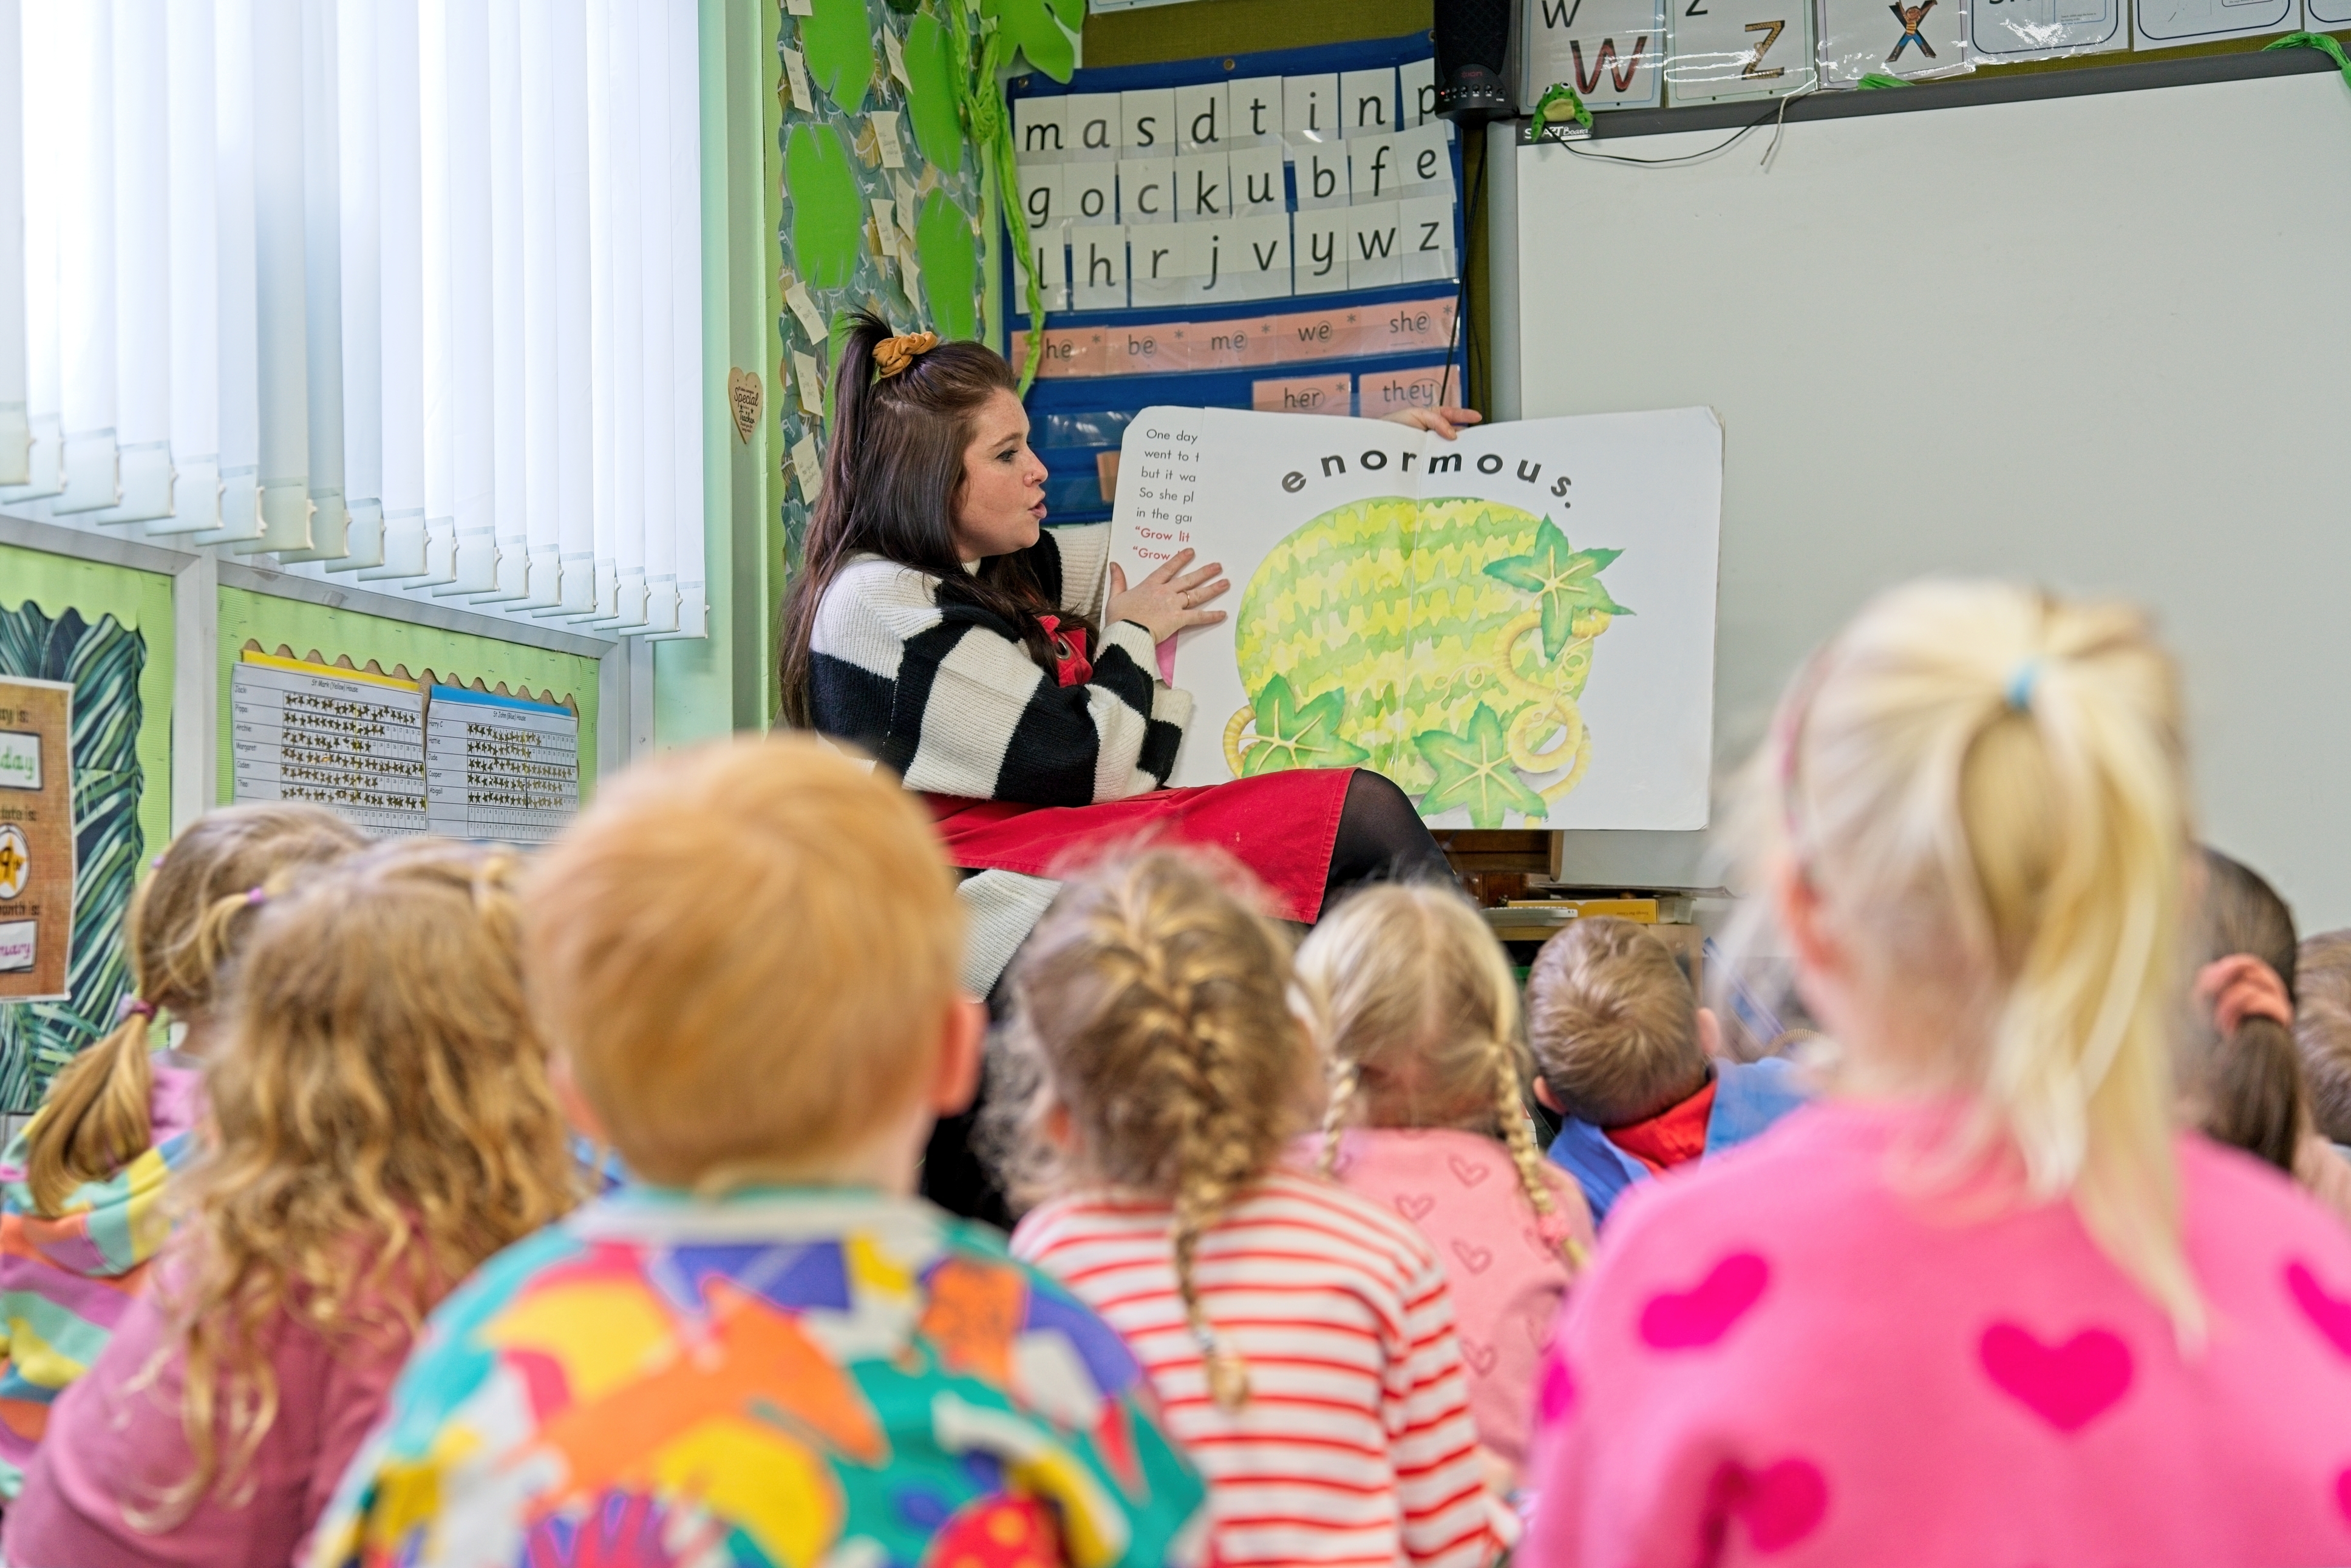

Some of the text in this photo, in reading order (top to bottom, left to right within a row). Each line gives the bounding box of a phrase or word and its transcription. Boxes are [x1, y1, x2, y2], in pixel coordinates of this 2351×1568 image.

[1026, 84, 1435, 151] m a s d t i n p
[1525, 126, 1563, 139] SART
[1029, 146, 1436, 228] g o c k u b f e
[1038, 222, 1438, 290] l h r j v y w z
[1046, 311, 1427, 358] he be me we she
[734, 387, 758, 407] Special
[1284, 380, 1434, 408] her they
[739, 410, 755, 424] Teacher
[1147, 429, 1197, 444] One day
[1145, 450, 1171, 459] went
[1179, 451, 1188, 461] to
[1141, 466, 1159, 478] but
[1166, 470, 1172, 479] it
[1282, 450, 1571, 509] enormous.
[1140, 487, 1193, 504] So she pl
[1137, 507, 1145, 517] in
[1152, 508, 1169, 520] the
[1179, 531, 1190, 543] lit
[330, 681, 345, 692] (Yellow)
[235, 704, 248, 714] Pippa
[506, 712, 515, 721] (Blue)
[429, 720, 439, 728] Harry
[236, 742, 256, 752] Margaret
[0, 903, 25, 915] onth
